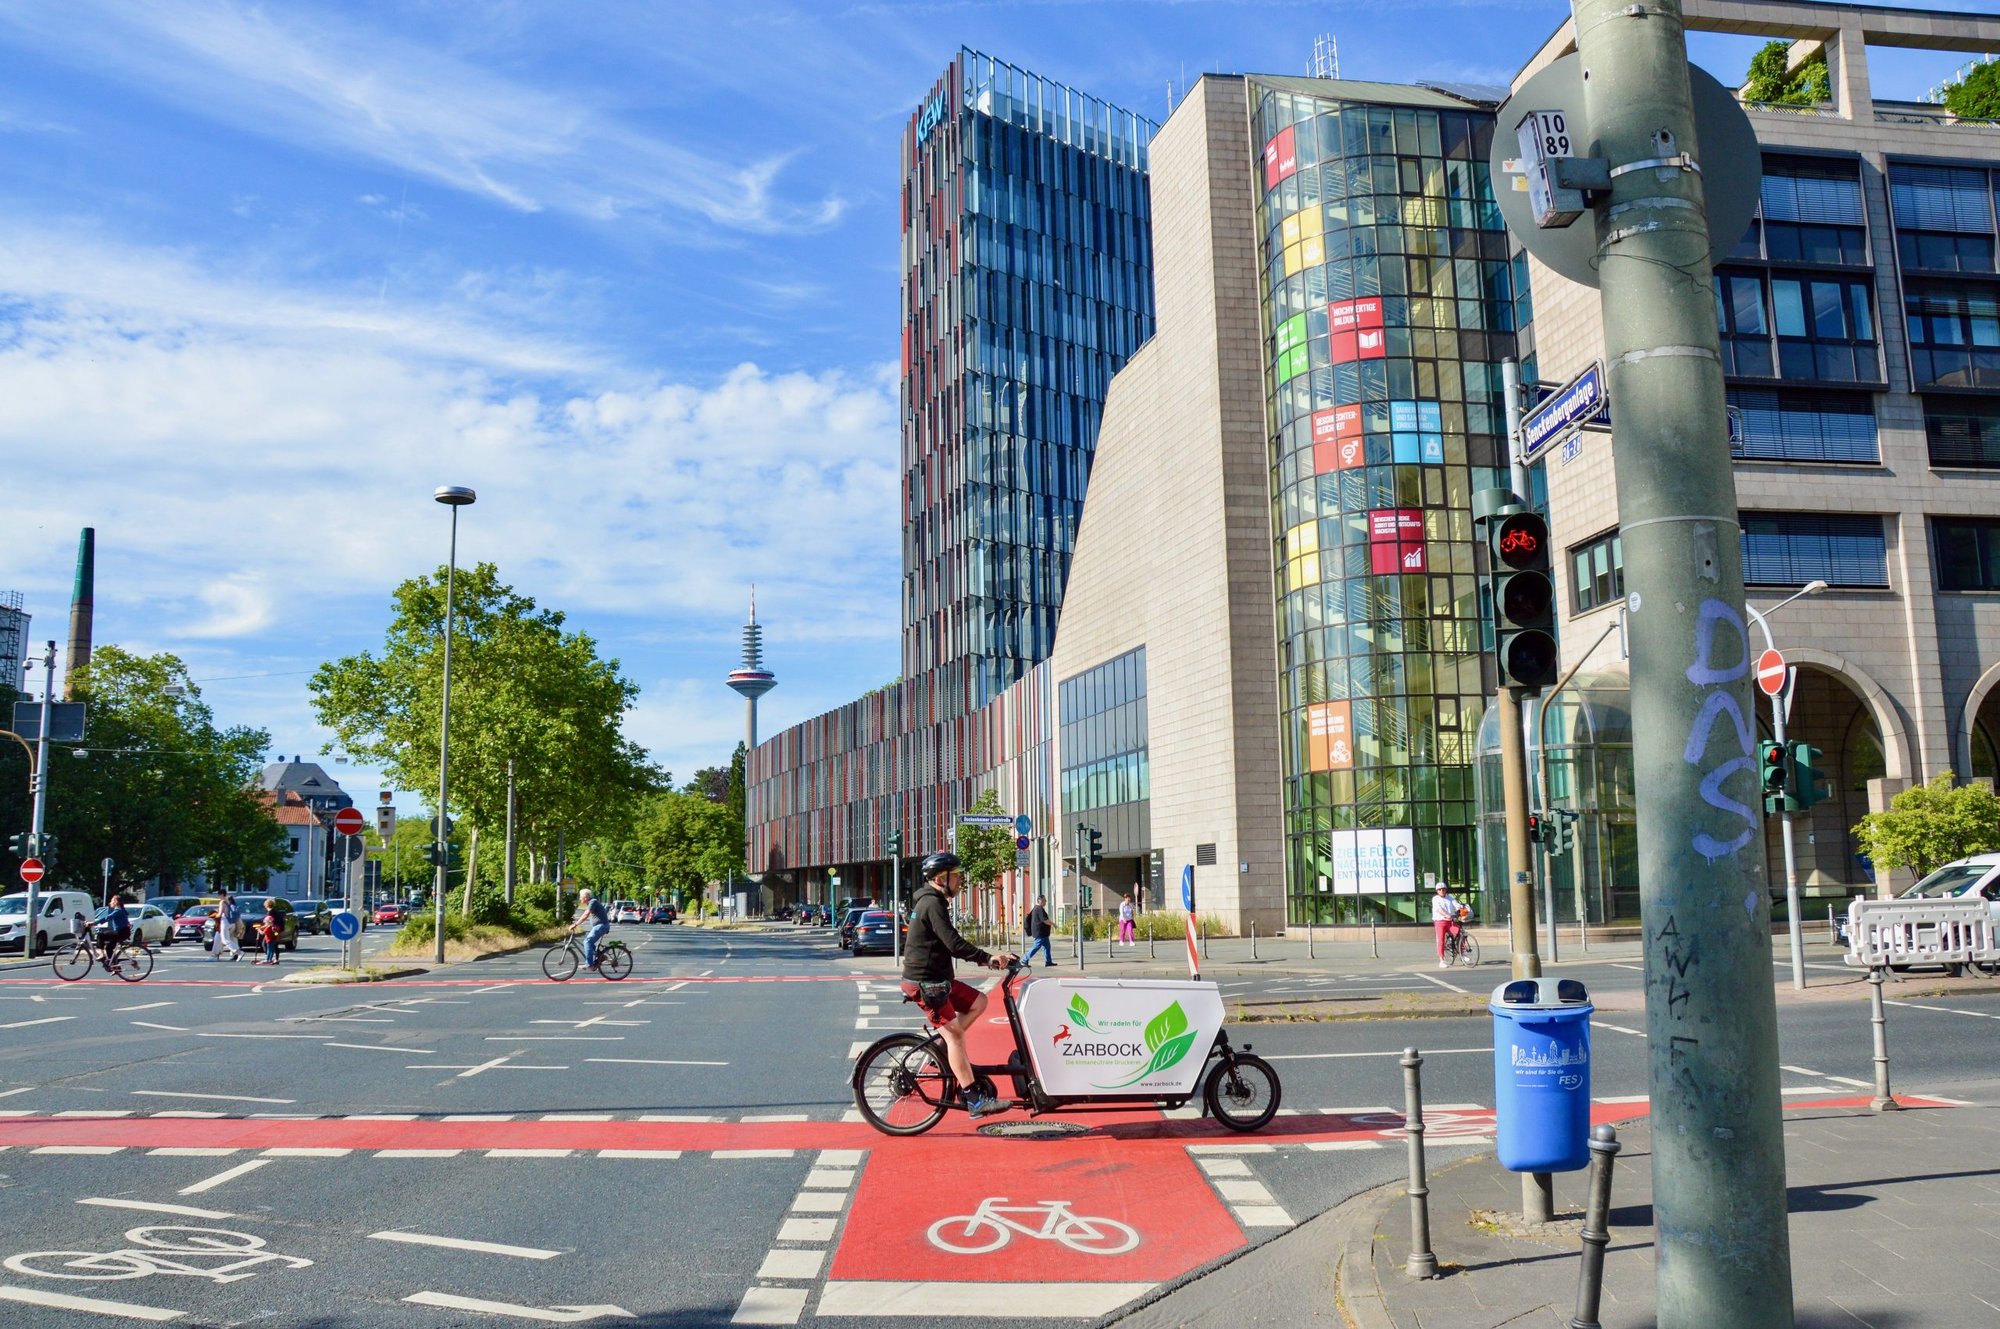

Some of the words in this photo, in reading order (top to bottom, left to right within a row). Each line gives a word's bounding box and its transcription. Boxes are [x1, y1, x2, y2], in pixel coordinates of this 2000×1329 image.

[1542, 114, 1565, 133] 10
[1545, 136, 1569, 155] 89
[1527, 381, 1594, 446] Senckenberganlage
[1369, 844, 1393, 857] FÜR
[1337, 858, 1410, 869] NACHHALTIGE
[1337, 869, 1410, 879] ENTWICKLUNG
[1062, 1043, 1143, 1057] ZARBOCK
[1559, 1074, 1578, 1085] FES
